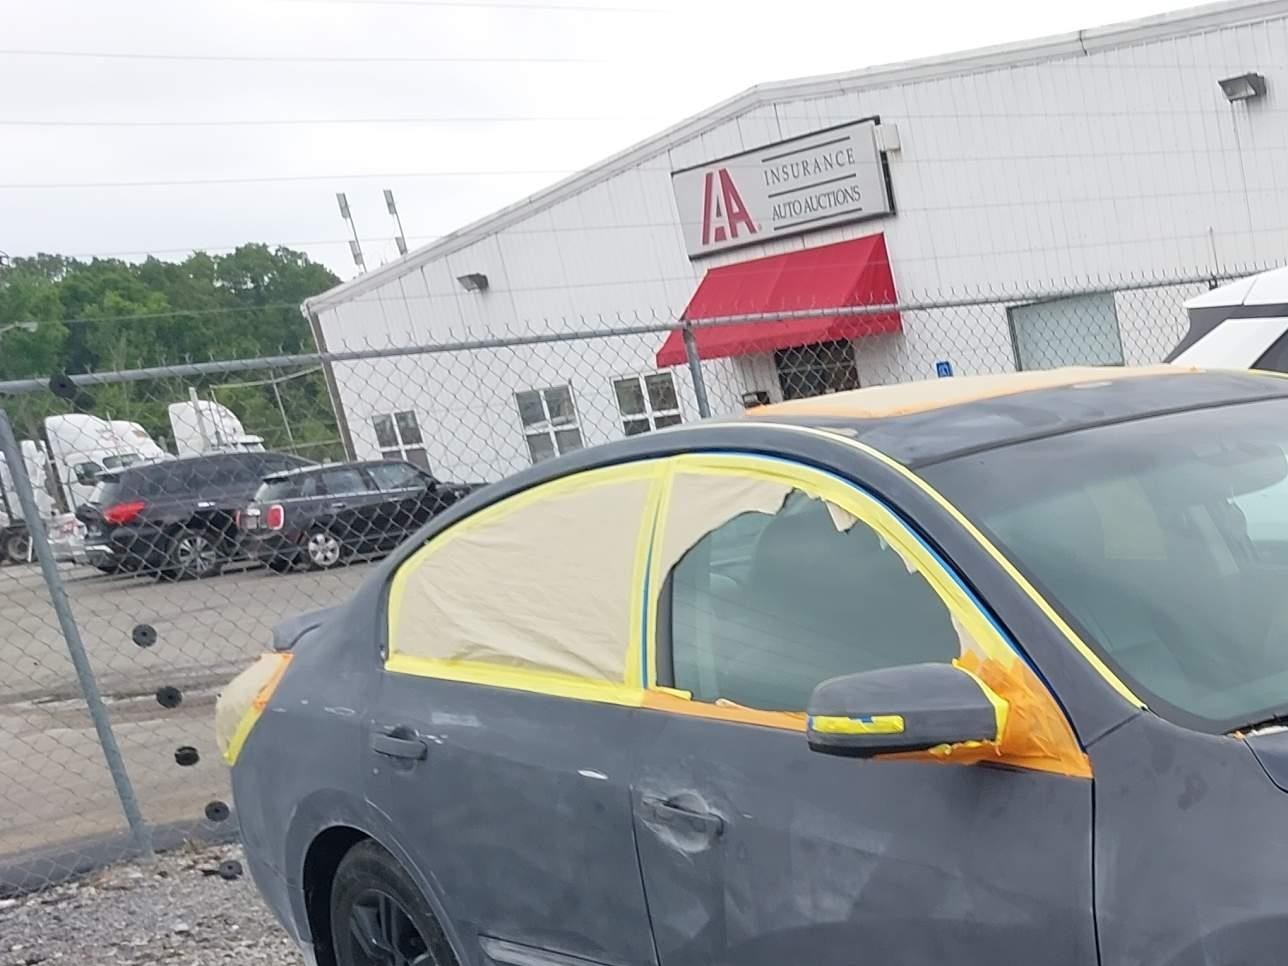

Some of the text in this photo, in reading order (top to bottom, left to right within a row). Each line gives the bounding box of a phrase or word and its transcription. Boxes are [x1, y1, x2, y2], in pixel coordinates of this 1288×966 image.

[763, 147, 856, 186] INSURANCE
[772, 185, 862, 222] AUTO AUCTIONS
